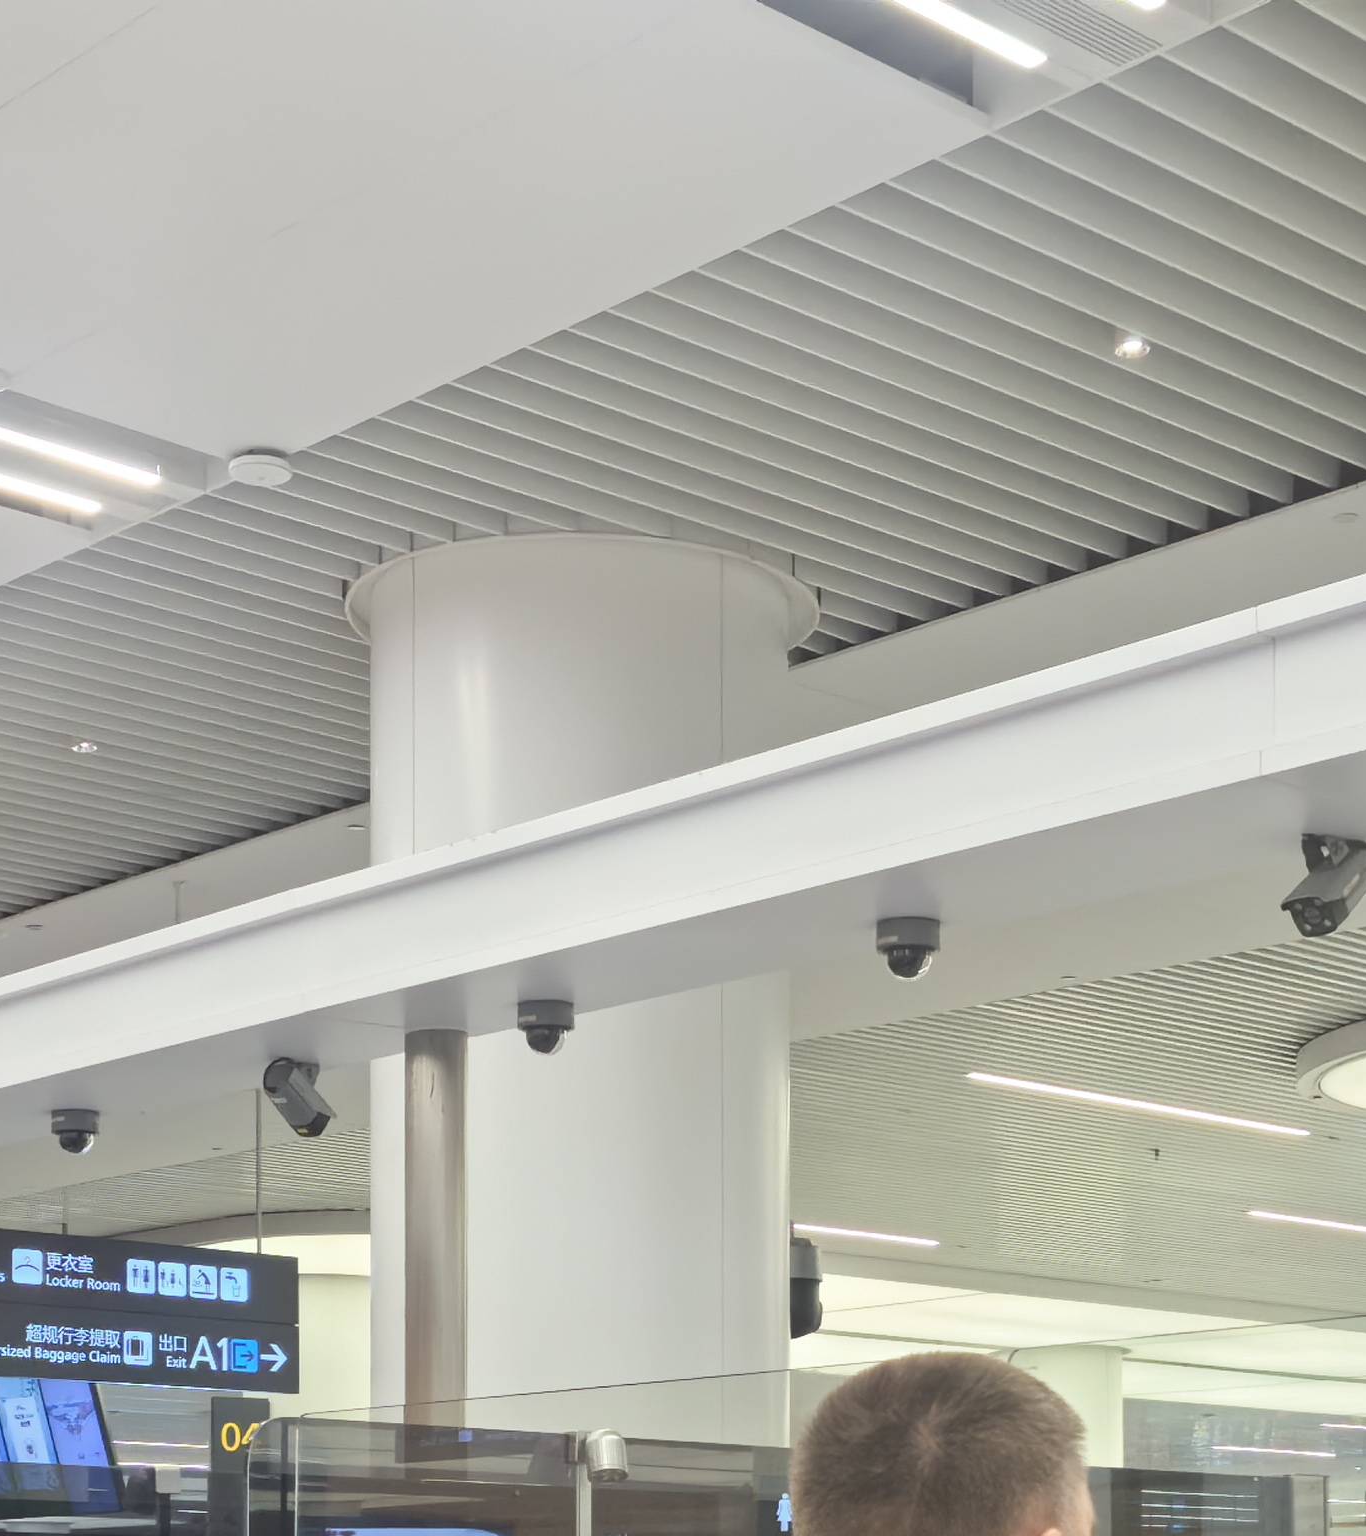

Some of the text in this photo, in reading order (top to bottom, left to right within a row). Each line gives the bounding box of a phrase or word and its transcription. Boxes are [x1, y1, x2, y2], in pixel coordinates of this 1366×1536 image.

[46, 1252, 94, 1274] 更衣室
[46, 1273, 121, 1292] Locker Room
[26, 1323, 121, 1348] 超规行李提取
[159, 1333, 187, 1352] 出口
[34, 1345, 86, 1364] Baggage
[88, 1350, 121, 1364] Claim
[166, 1355, 187, 1369] Exit
[189, 1335, 229, 1372] A1
